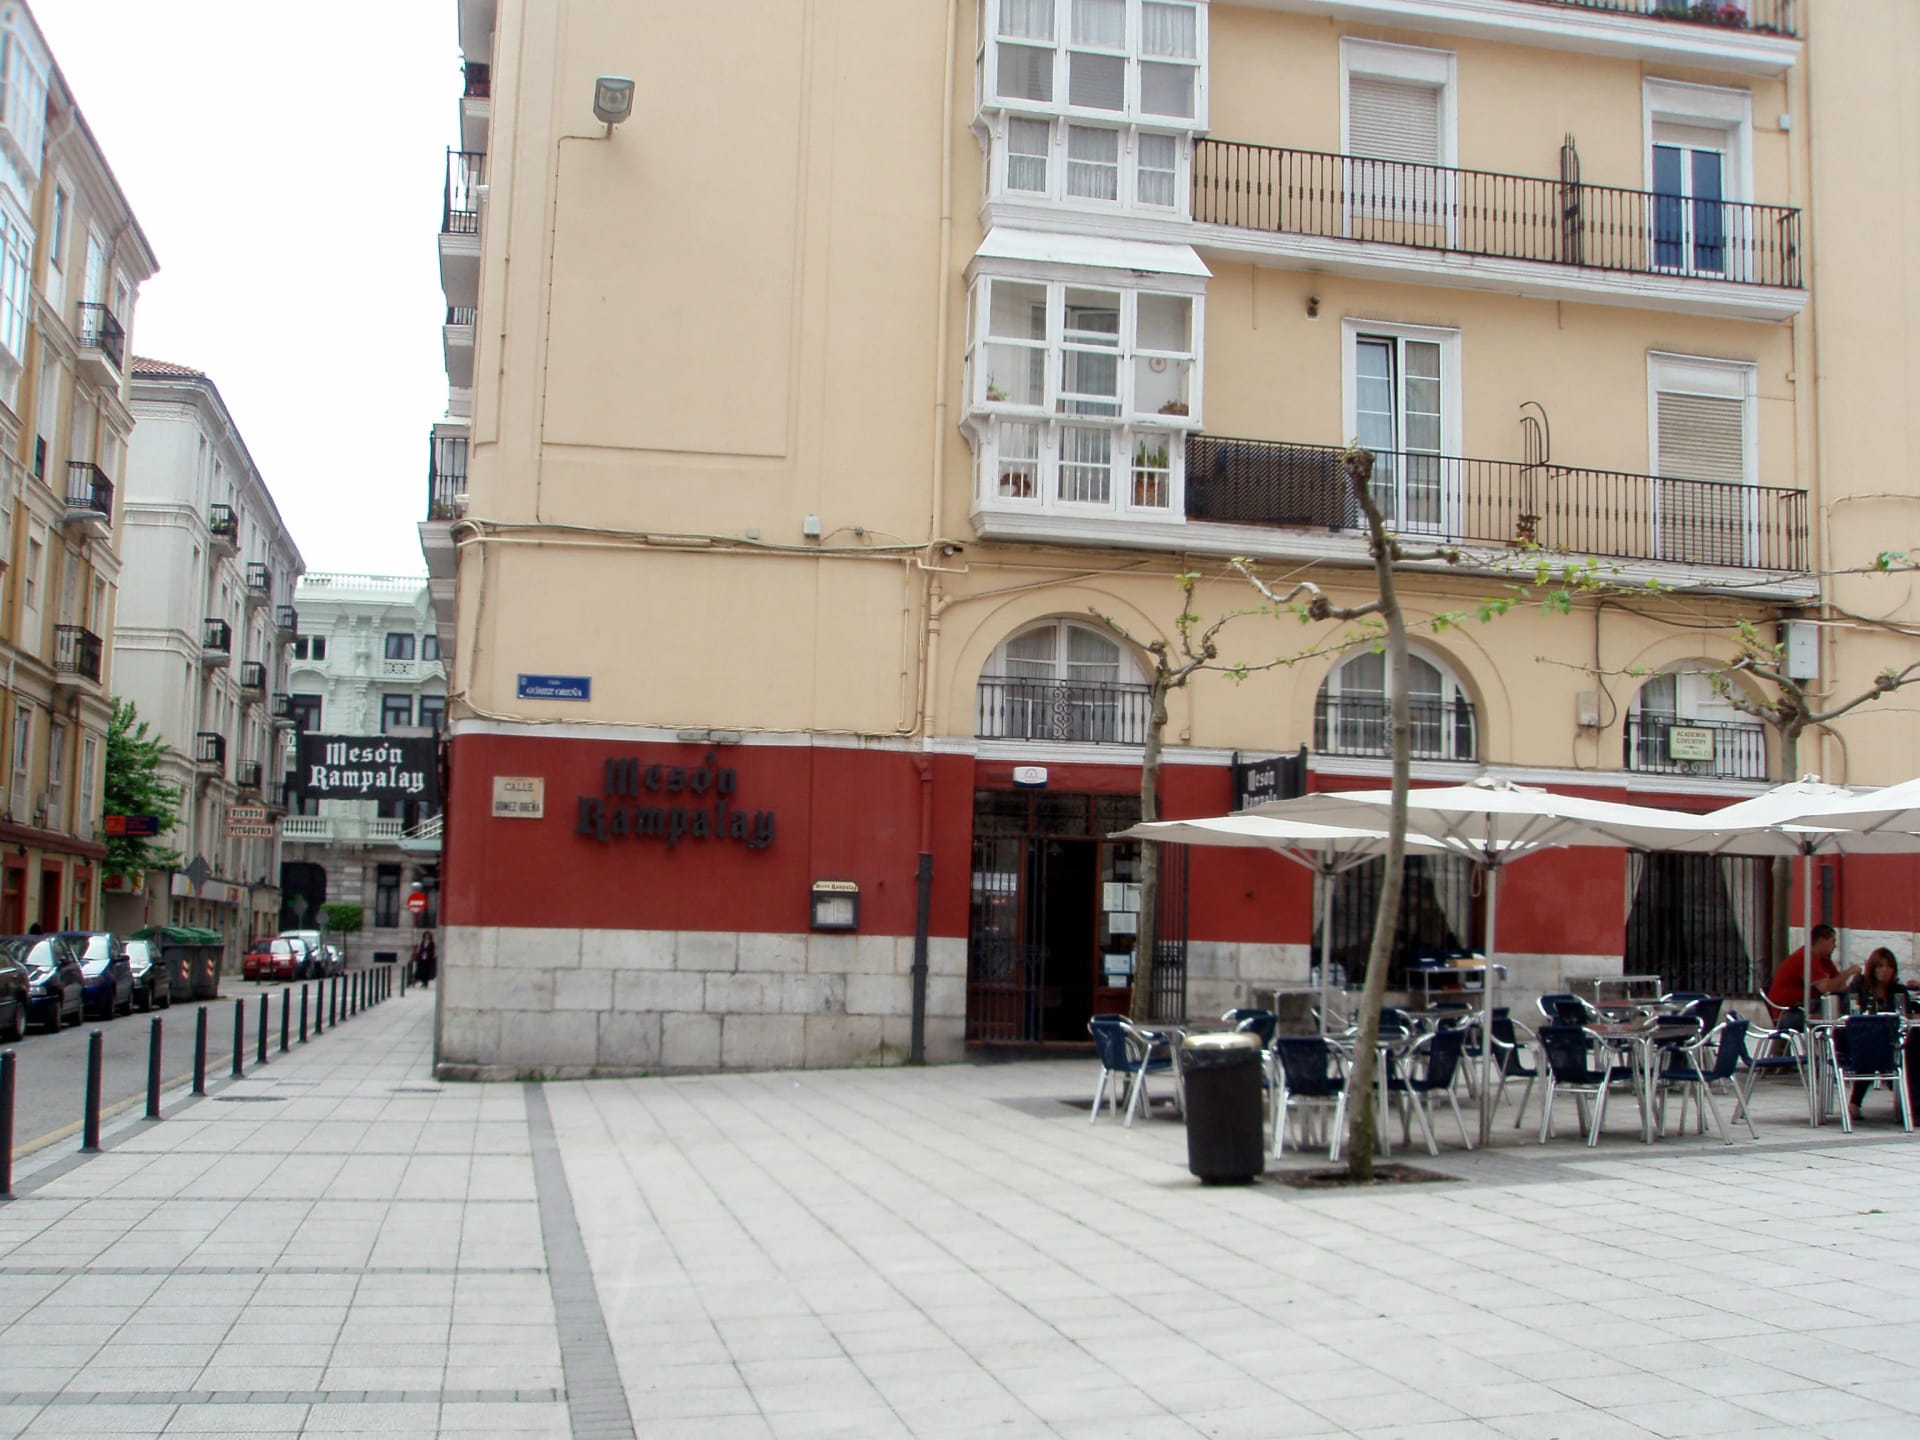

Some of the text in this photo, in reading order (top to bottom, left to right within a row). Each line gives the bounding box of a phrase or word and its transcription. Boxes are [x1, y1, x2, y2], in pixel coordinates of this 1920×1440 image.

[326, 742, 403, 766] Mesón
[308, 765, 425, 793] Rampalay
[504, 782, 534, 792] CALLE
[605, 751, 737, 796] Mesón
[576, 795, 776, 849] Rampalay
